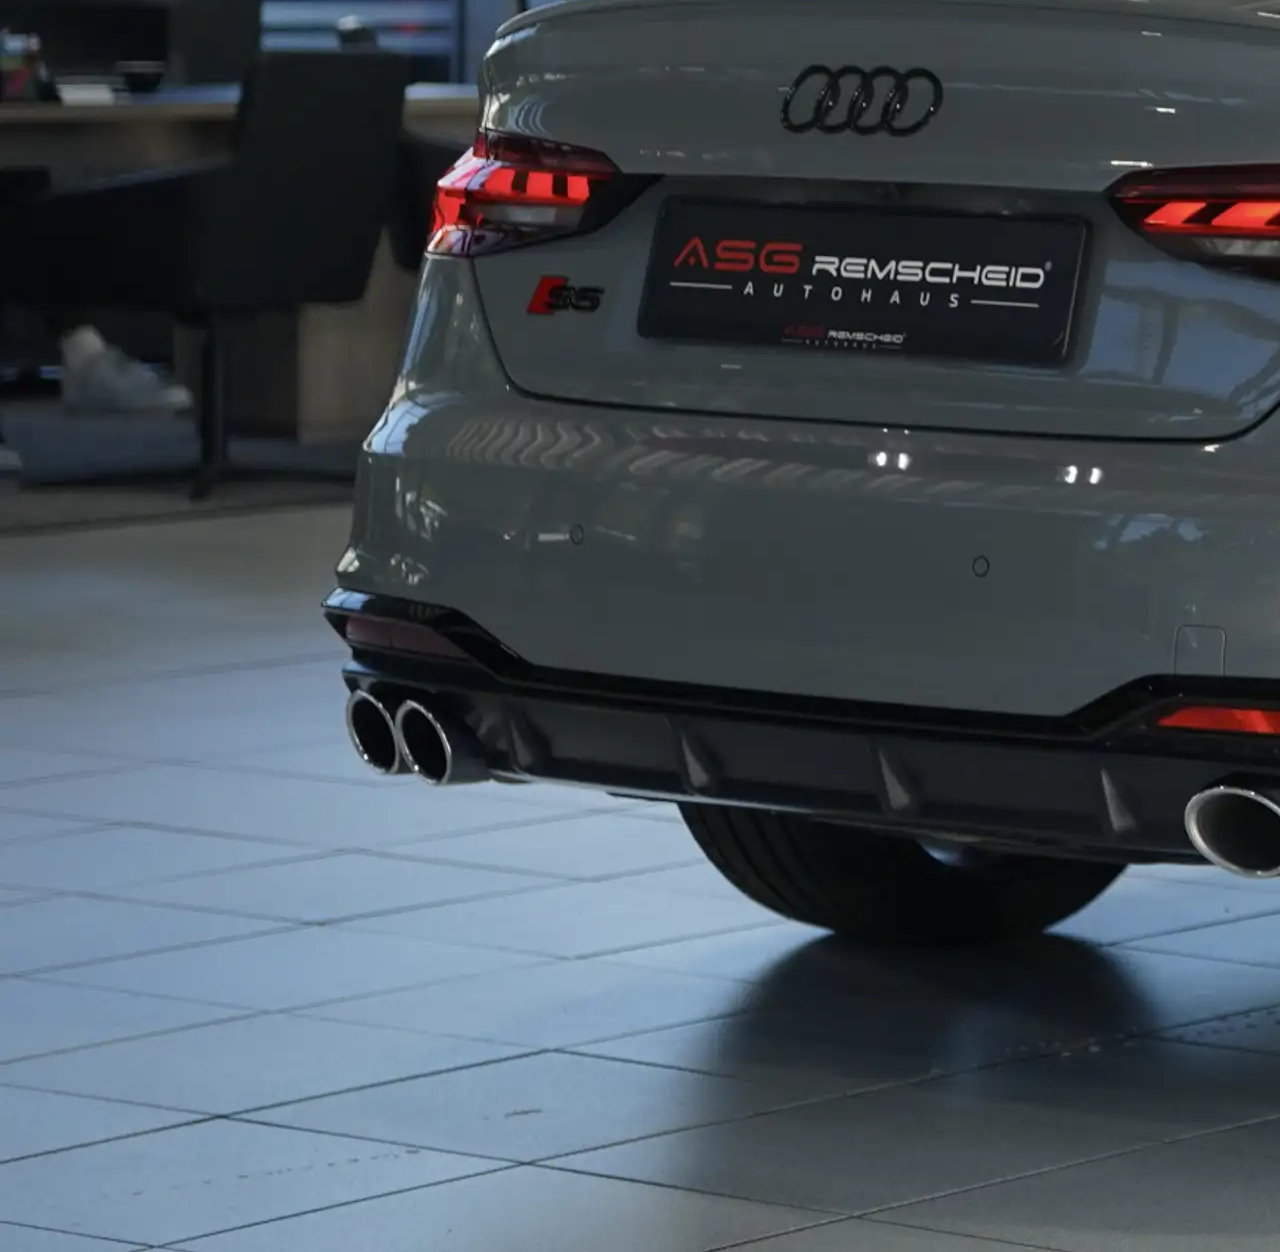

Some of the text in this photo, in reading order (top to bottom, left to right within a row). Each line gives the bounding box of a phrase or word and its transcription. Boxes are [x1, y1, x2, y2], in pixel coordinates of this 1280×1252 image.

[674, 236, 1045, 288] ASG REMSCHEID
[545, 284, 605, 312] S5
[743, 281, 960, 308] AUTOHAUS
